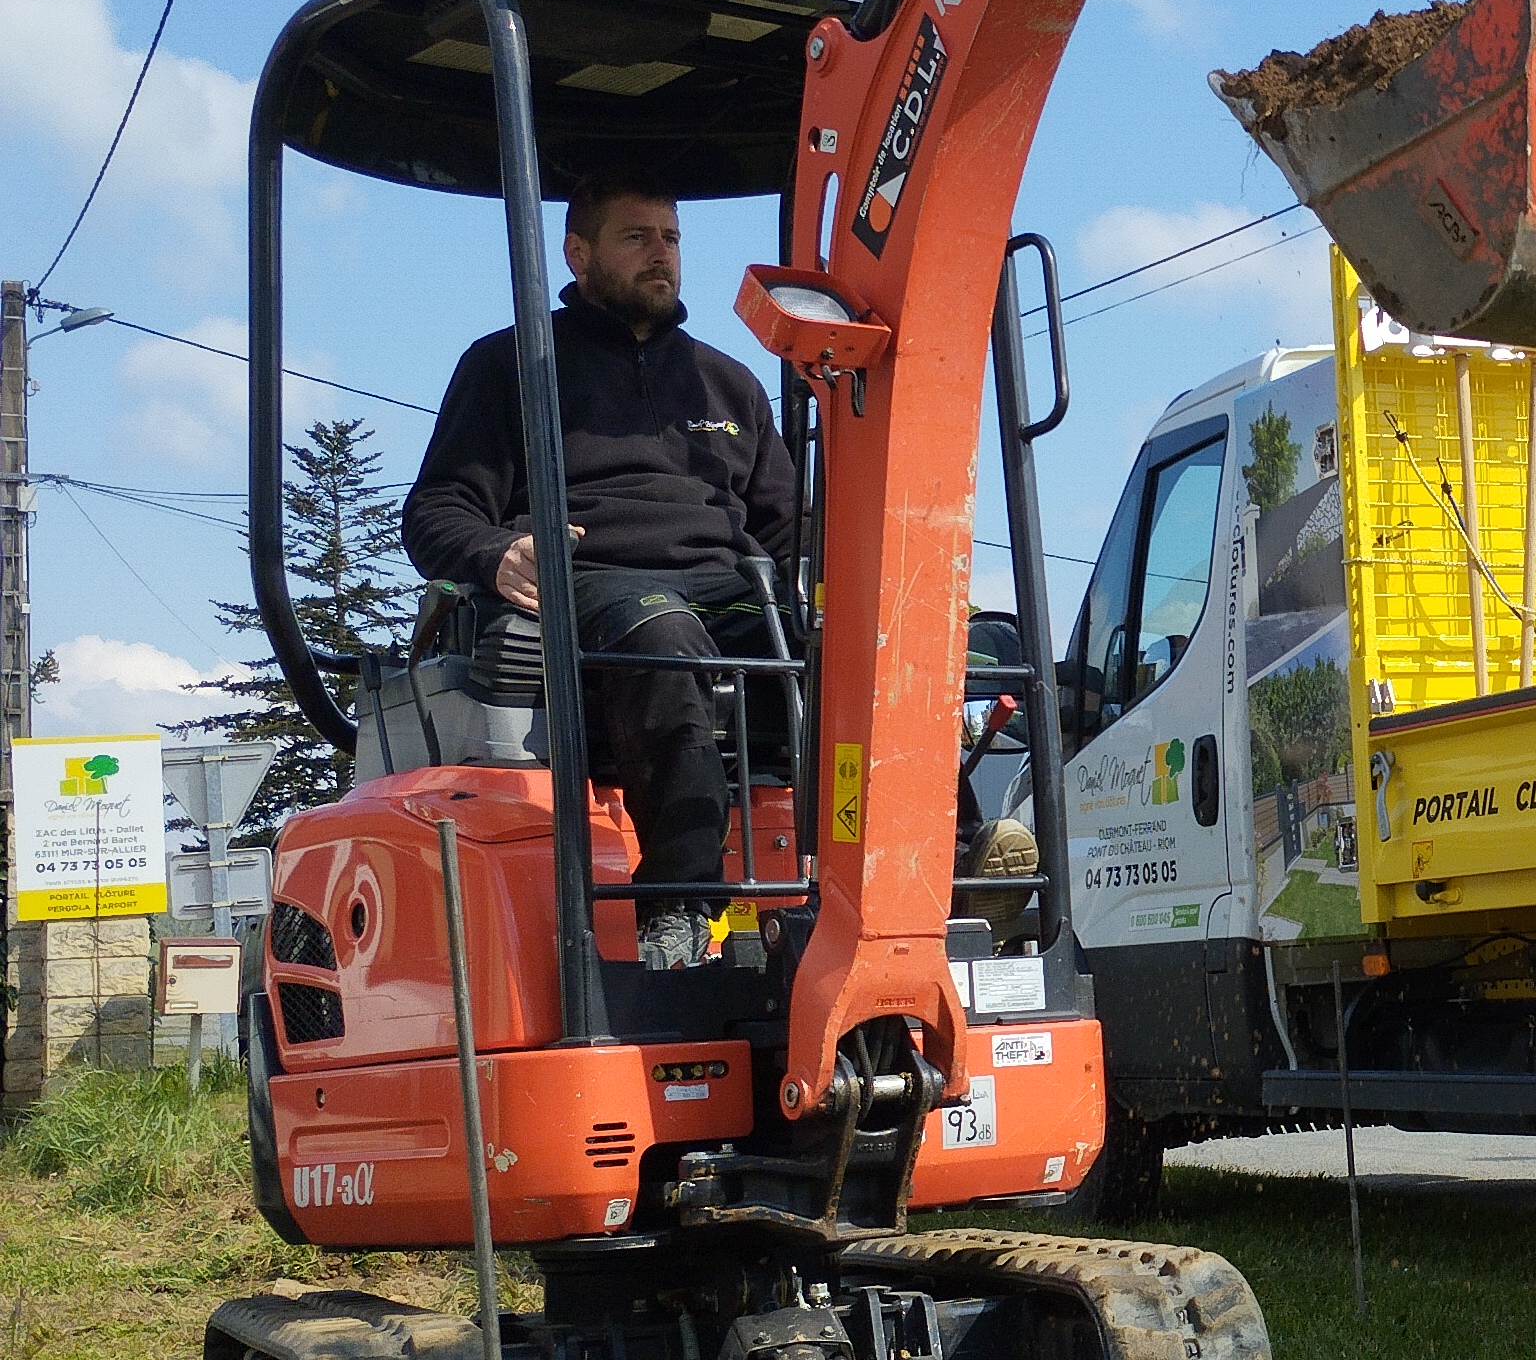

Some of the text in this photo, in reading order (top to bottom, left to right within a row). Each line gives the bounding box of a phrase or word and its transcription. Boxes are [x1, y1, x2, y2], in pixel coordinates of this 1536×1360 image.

[878, 148, 887, 166] de
[884, 104, 903, 152] location
[1077, 745, 1151, 811] Daniel Moquet
[44, 796, 82, 813] Daniel
[1413, 787, 1498, 825] PORTAIL
[1098, 820, 1167, 840] CLERMONT-FERRAND
[43, 840, 49, 848] 2
[36, 858, 147, 873] 04 73 73 05 05
[1086, 860, 1177, 889] 04 73 73 05 05
[50, 893, 89, 901] PORTAIL
[48, 904, 90, 913] PERGOLA
[995, 1050, 1029, 1060] THEFT
[948, 1109, 992, 1142] 93 dB
